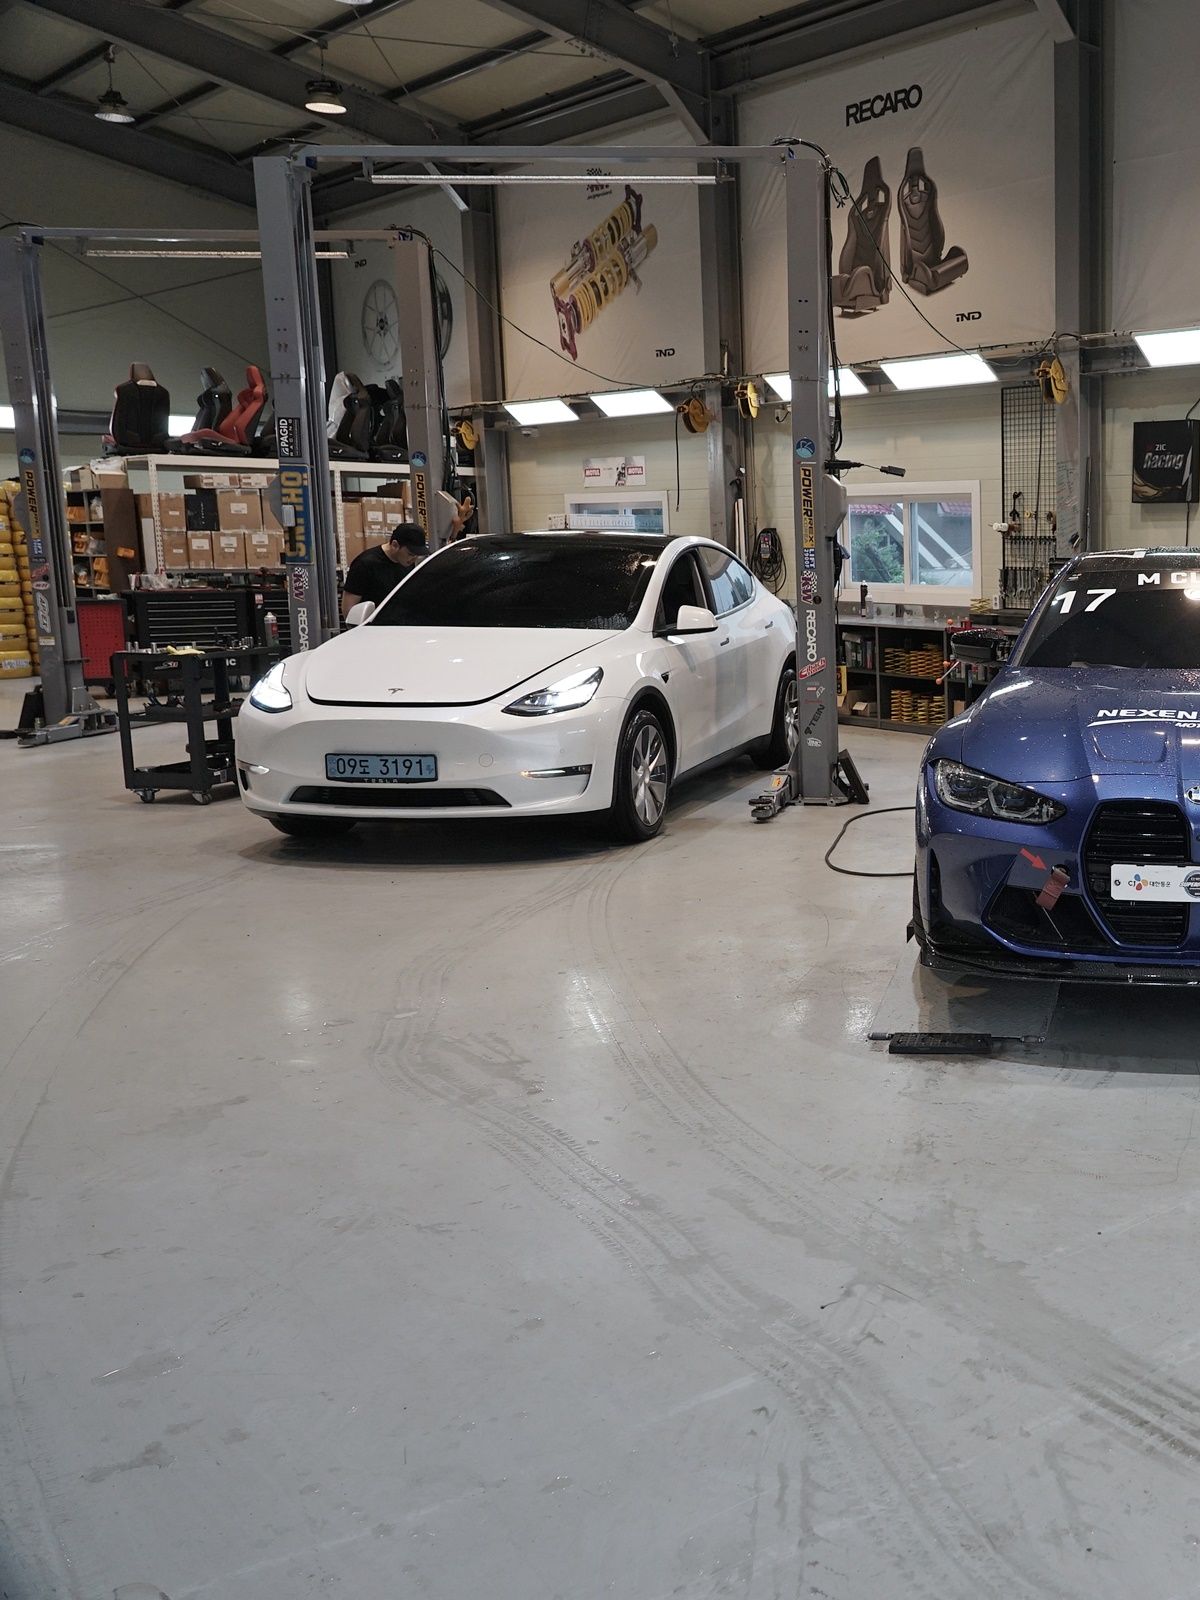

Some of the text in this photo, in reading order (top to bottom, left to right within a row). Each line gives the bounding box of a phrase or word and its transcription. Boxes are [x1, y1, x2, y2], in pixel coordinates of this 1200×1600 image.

[846, 84, 923, 127] RECARO
[280, 419, 288, 447] PAGID
[1155, 443, 1167, 451] ZIC
[1143, 452, 1184, 470] Racing
[1138, 573, 1161, 586] M
[1054, 588, 1117, 614] 17
[297, 607, 310, 653] RECAR
[806, 609, 817, 662] RECARO
[809, 704, 825, 726] TEIN
[1097, 709, 1199, 720] NEXEN
[336, 758, 423, 776] 09도 3191
[1128, 880, 1136, 888] CJ
